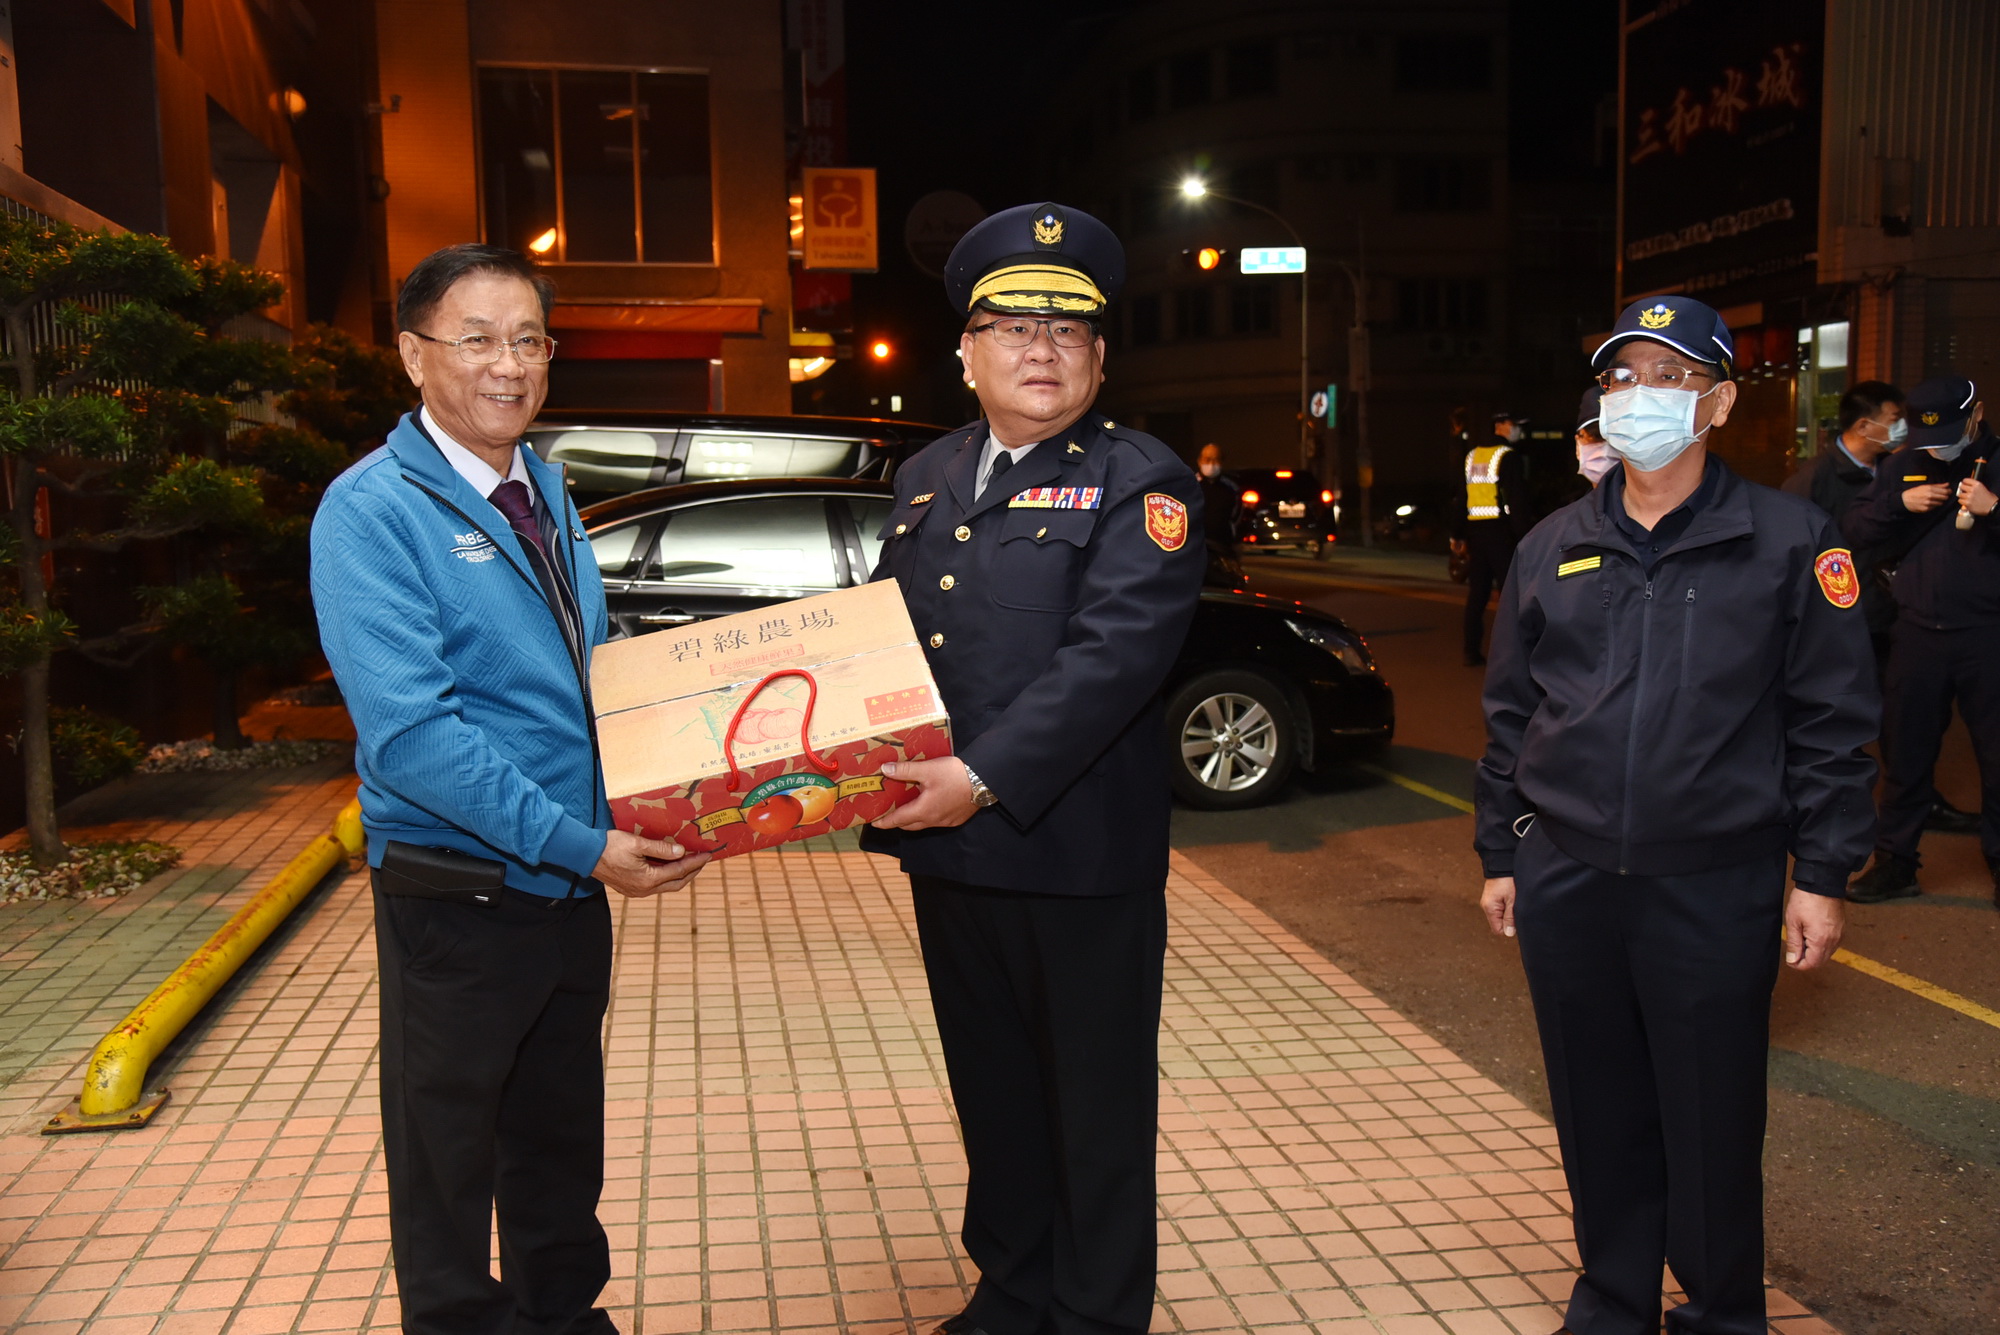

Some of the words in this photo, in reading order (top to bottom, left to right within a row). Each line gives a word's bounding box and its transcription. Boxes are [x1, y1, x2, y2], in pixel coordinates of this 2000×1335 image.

[1629, 42, 1802, 164] 三和冰城
[668, 608, 835, 662] 碧綠農場
[757, 776, 816, 797] 碧綠合作農場
